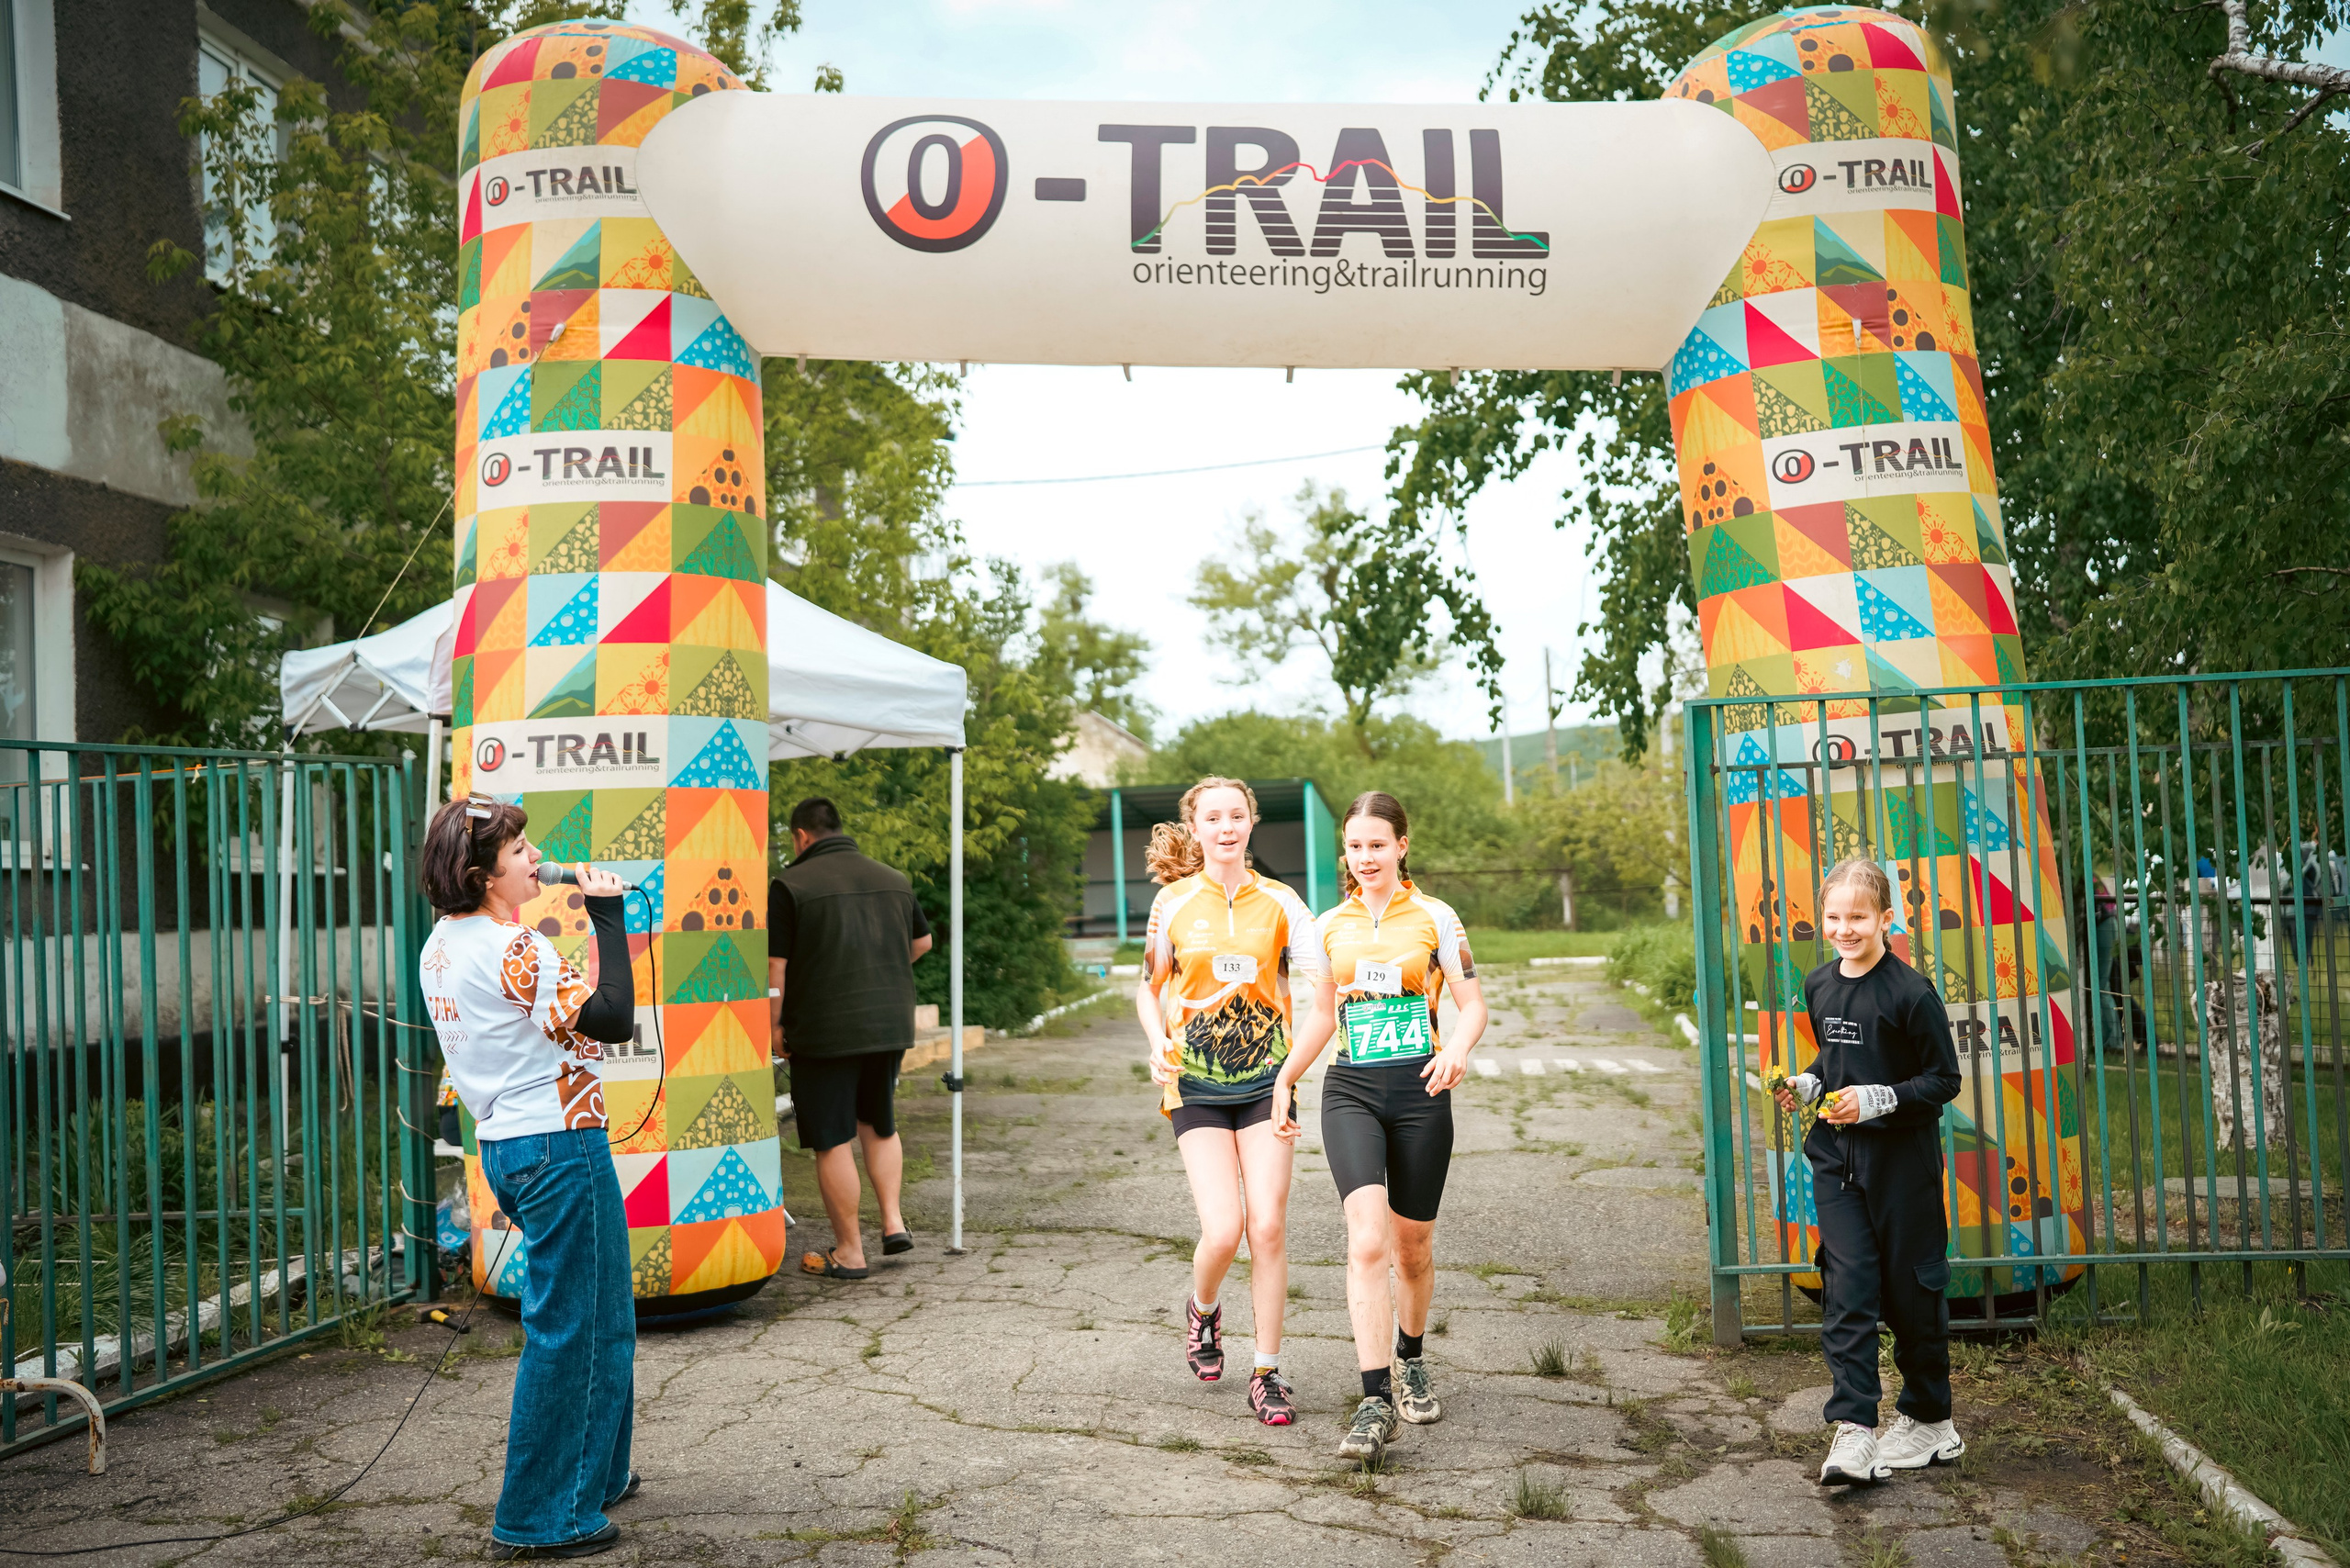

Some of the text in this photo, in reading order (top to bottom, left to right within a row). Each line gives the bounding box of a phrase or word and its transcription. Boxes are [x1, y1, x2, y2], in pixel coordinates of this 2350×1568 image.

[1847, 184, 1932, 196] orienteering&trailrunning
[535, 193, 638, 204] orienteering&trailrunning
[1132, 256, 1549, 296] orienteering&trailrunning
[1854, 469, 1964, 482] orenteering&trailrunning
[543, 477, 666, 487] orienteering&trailrunning
[536, 764, 660, 775] orienteering&trailrunning
[1223, 963, 1241, 973] 133
[1367, 970, 1386, 982] 129
[1353, 1017, 1426, 1057] 744
